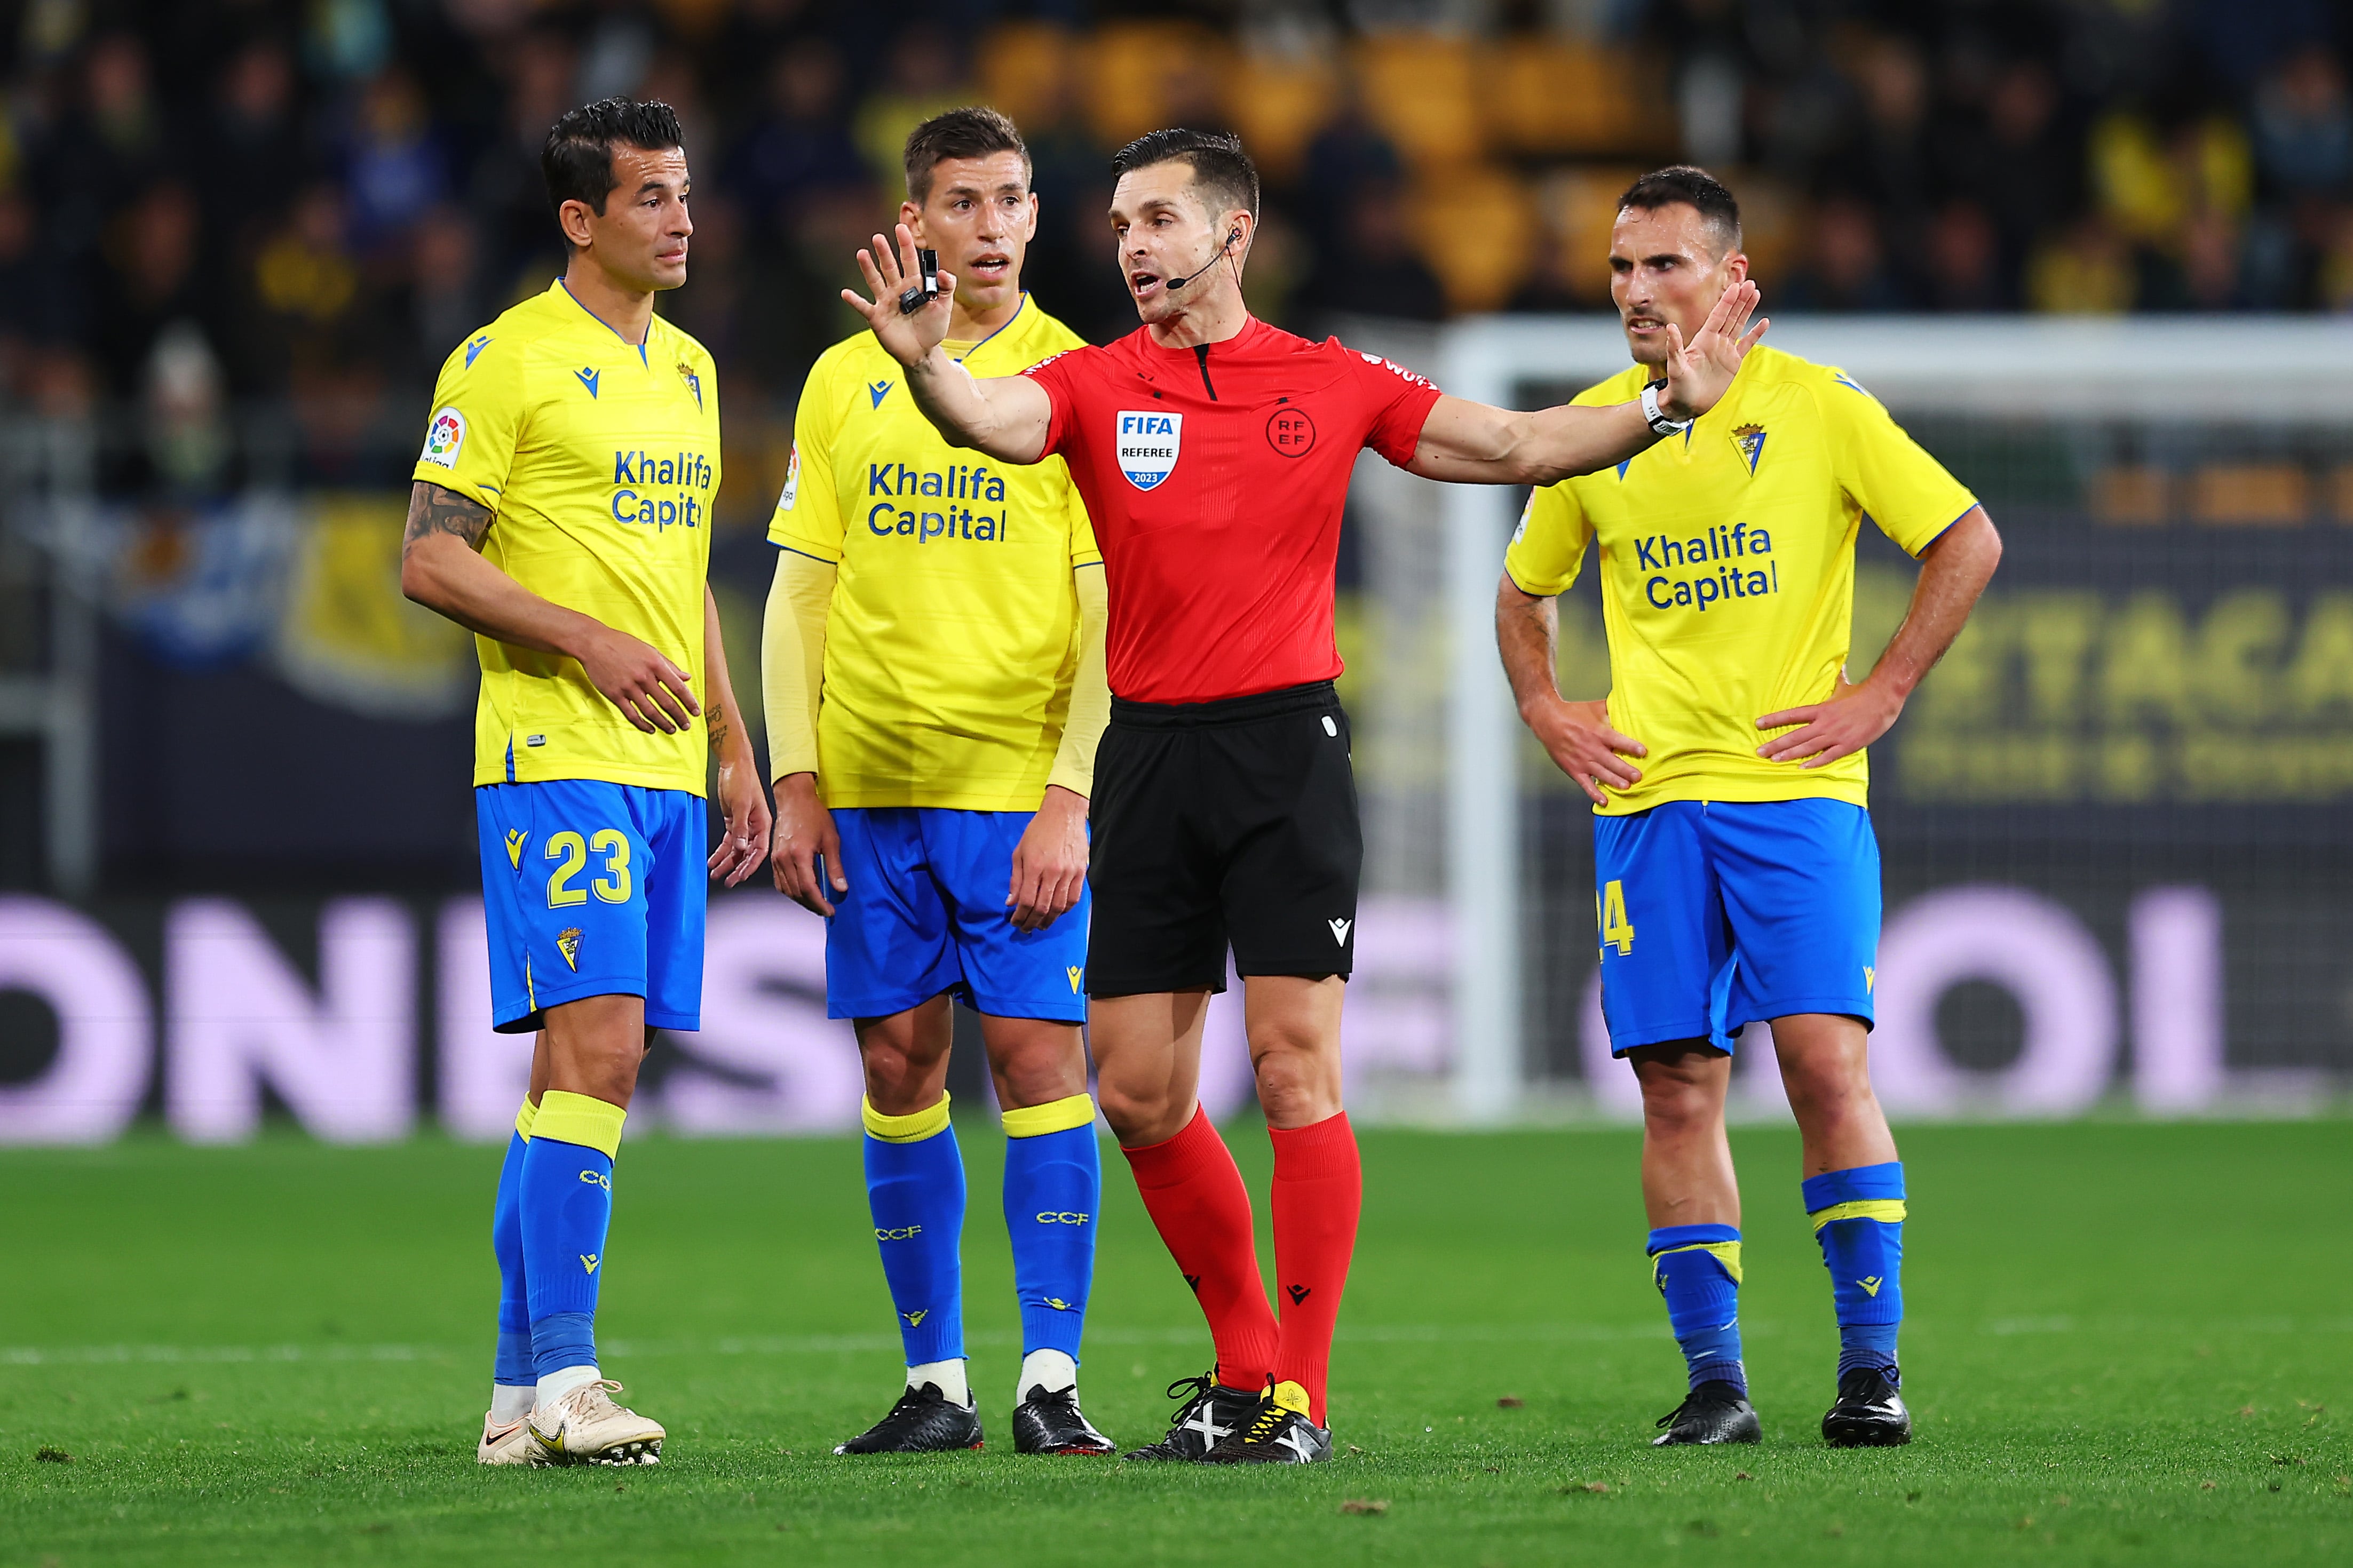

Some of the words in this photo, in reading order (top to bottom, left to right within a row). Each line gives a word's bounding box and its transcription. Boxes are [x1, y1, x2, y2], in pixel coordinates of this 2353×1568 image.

[1122, 417, 1173, 435] FIFA
[614, 451, 711, 490] Khalifa
[1122, 448, 1173, 458] REFEREE
[869, 463, 1005, 502] Khalifa
[1134, 473, 1158, 483] 2023
[868, 503, 1006, 544] Capital
[1634, 522, 1771, 572] Khalifa
[1645, 560, 1778, 612] Capital
[544, 828, 632, 910] 23
[1595, 879, 1635, 965] 4
[875, 1225, 922, 1241] CCF
[1036, 1211, 1089, 1227] CCF
